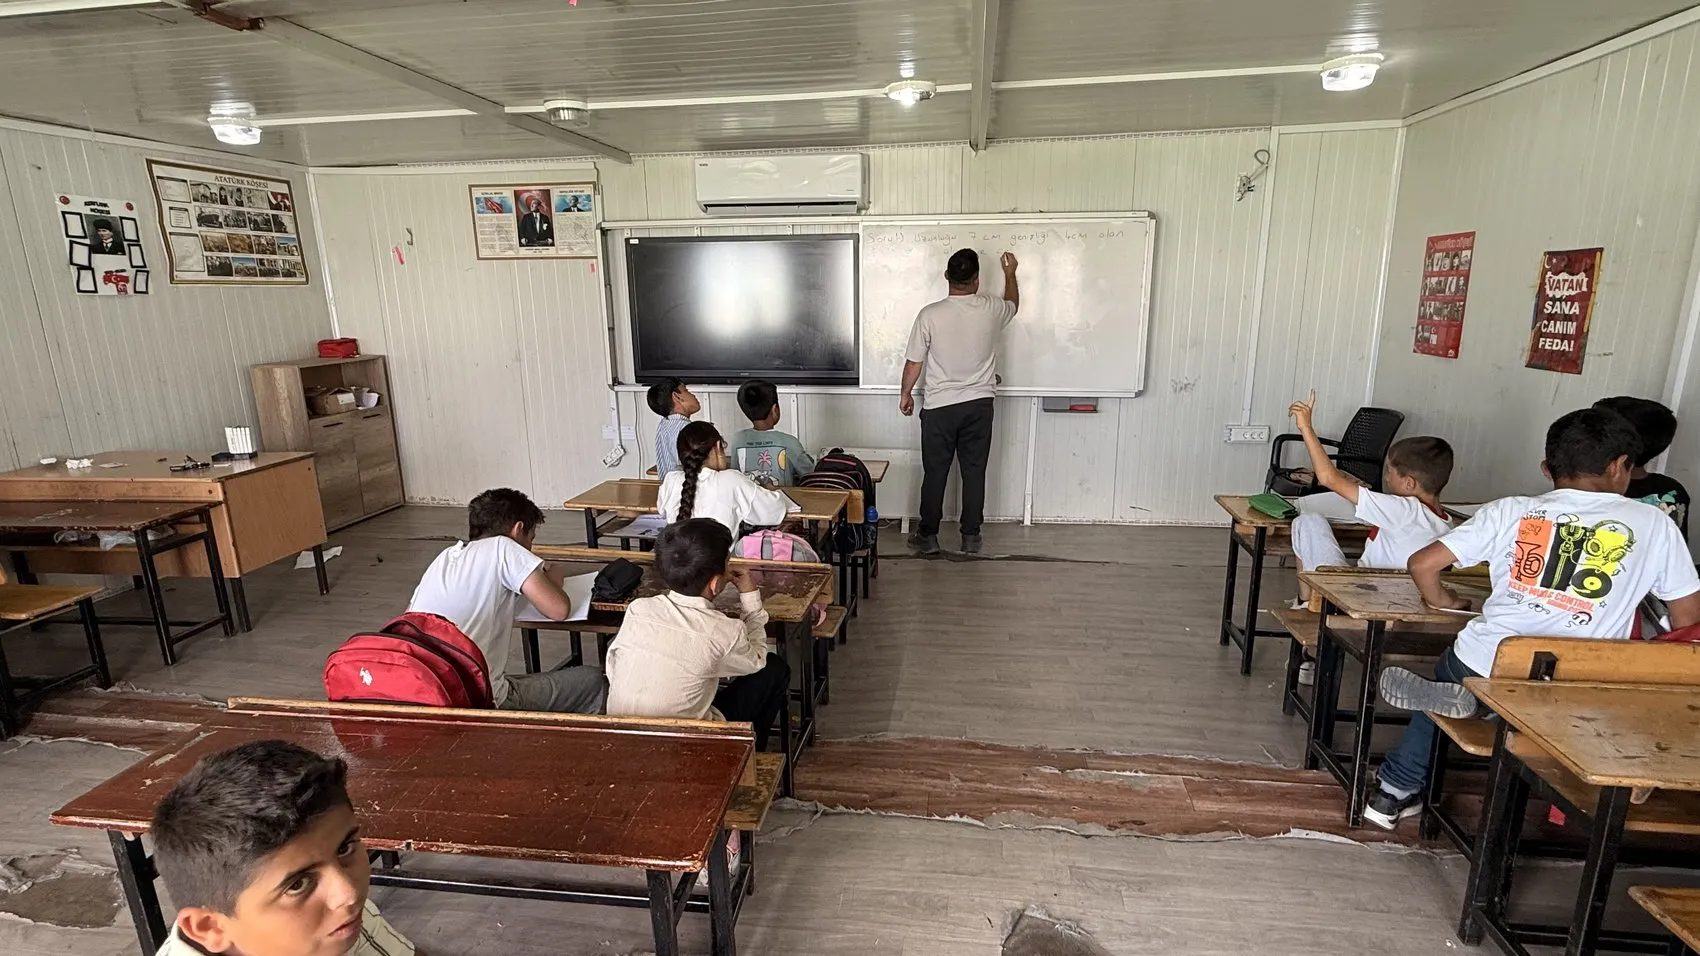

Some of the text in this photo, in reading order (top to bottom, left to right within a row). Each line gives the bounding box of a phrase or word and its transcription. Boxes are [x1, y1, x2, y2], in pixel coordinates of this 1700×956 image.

[214, 175, 245, 186] ATATÜRK
[1098, 227, 1124, 239] olan
[1547, 278, 1585, 291] VATAN
[1543, 301, 1580, 315] SANA
[1541, 320, 1577, 335] CANIM
[1538, 337, 1575, 352] FEDA!
[1508, 581, 1528, 593] KEEP
[1555, 593, 1594, 611] CONTROL
